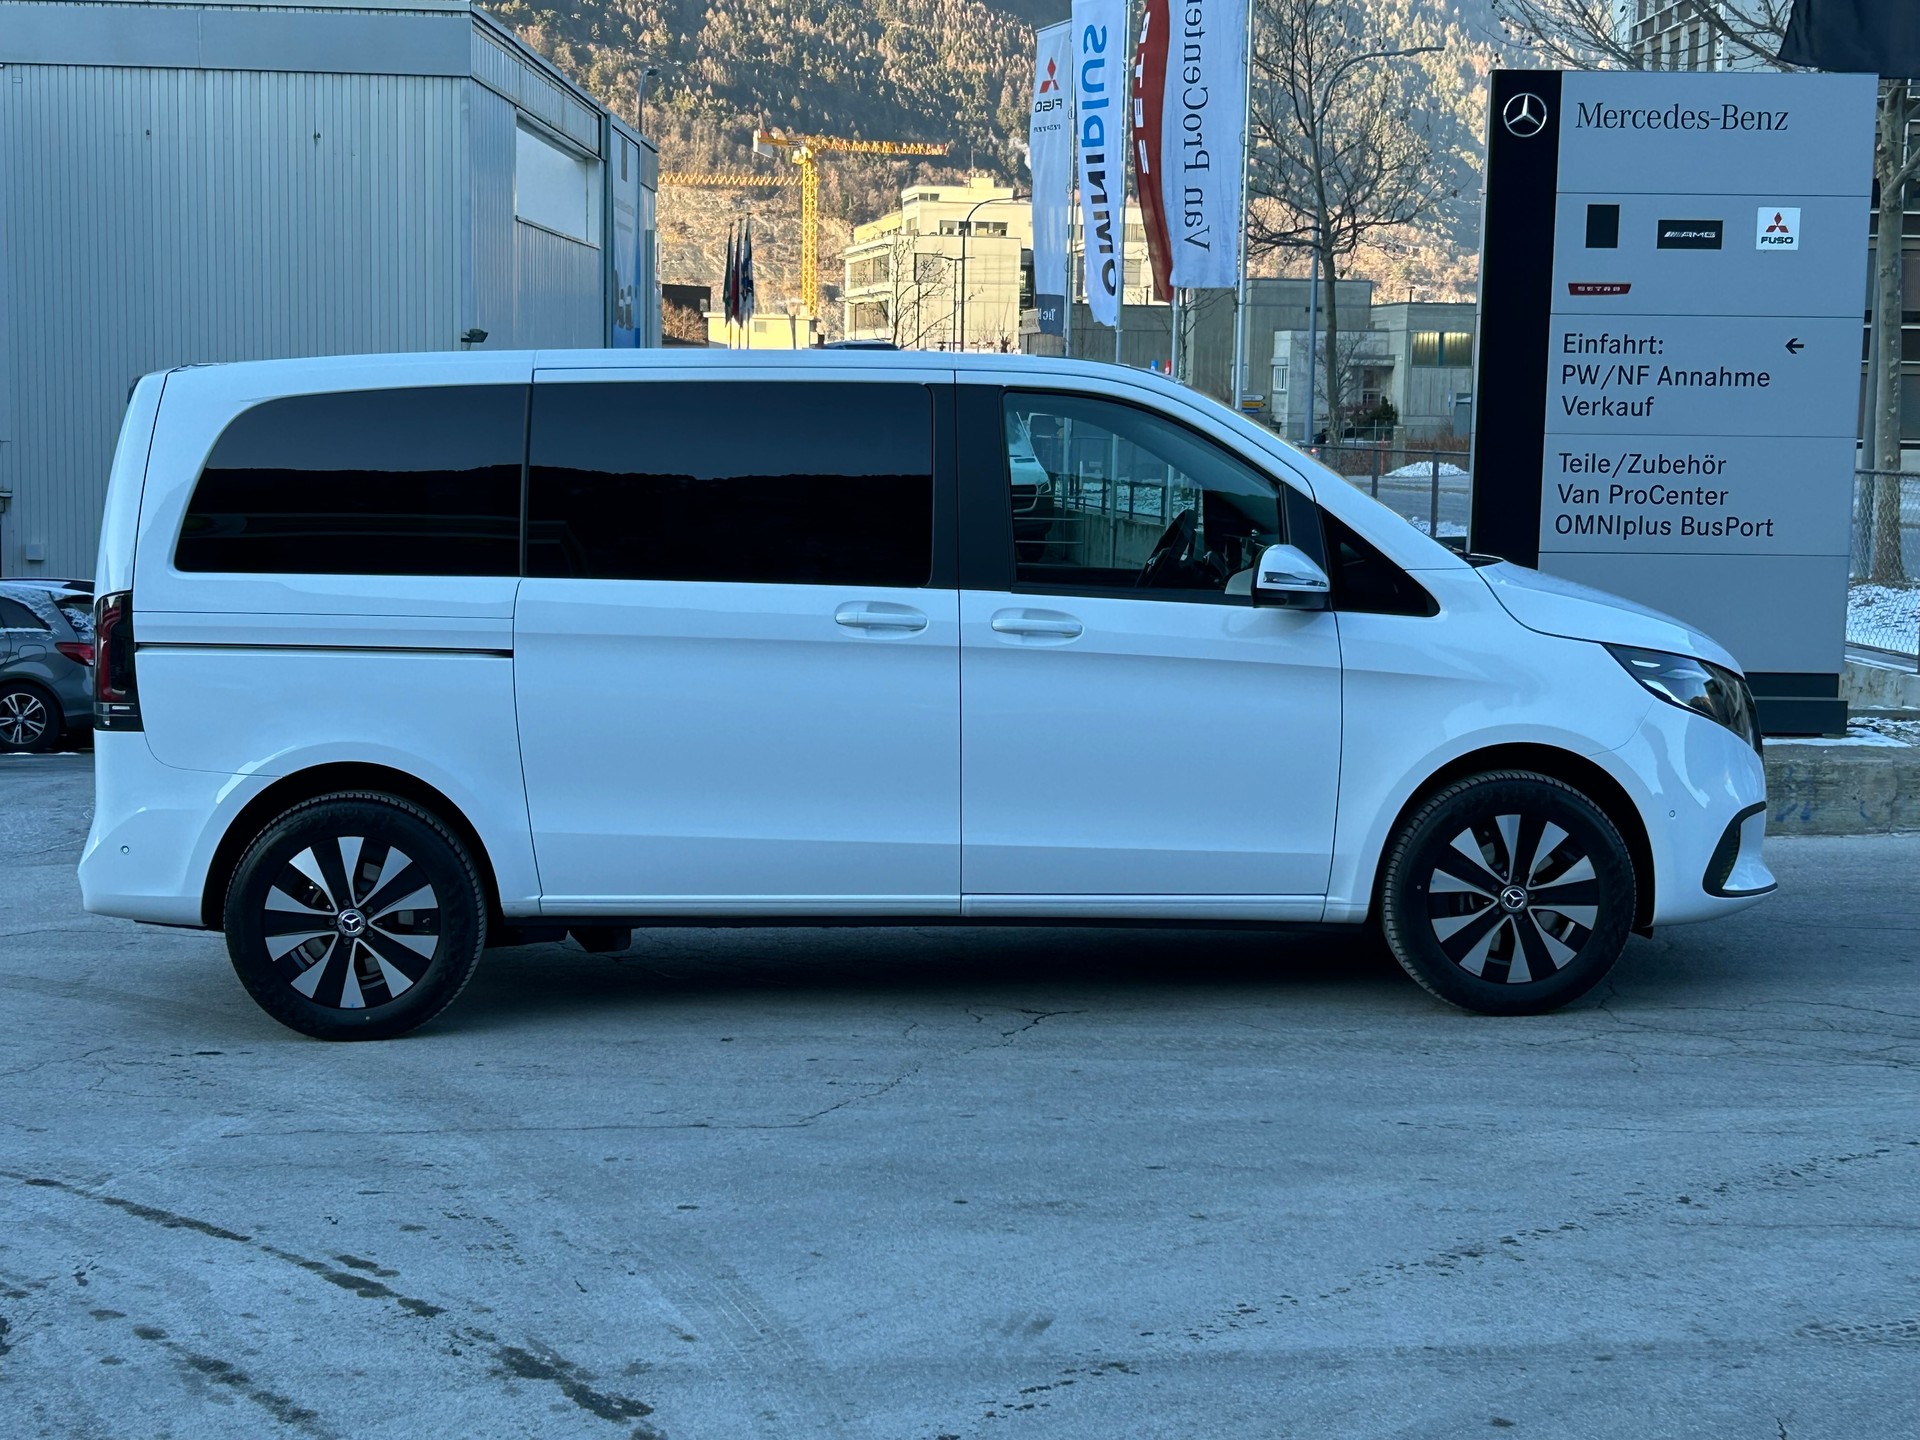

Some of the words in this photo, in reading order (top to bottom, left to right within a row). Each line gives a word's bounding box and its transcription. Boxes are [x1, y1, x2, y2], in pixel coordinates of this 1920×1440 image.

[1575, 101, 1790, 132] Mercedes-Benz
[1760, 236, 1794, 245] FUSO
[1562, 332, 1665, 356] Einfahrt:
[1561, 364, 1651, 390] PW/NF
[1656, 365, 1771, 388] Annahme
[1562, 395, 1655, 418] Verkauf
[1558, 452, 1728, 479] Teile/Zubehör
[1557, 484, 1600, 505] Van
[1608, 484, 1729, 506] ProCenter
[1554, 514, 1672, 541] OMNIplus
[1680, 516, 1774, 538] BusPort
